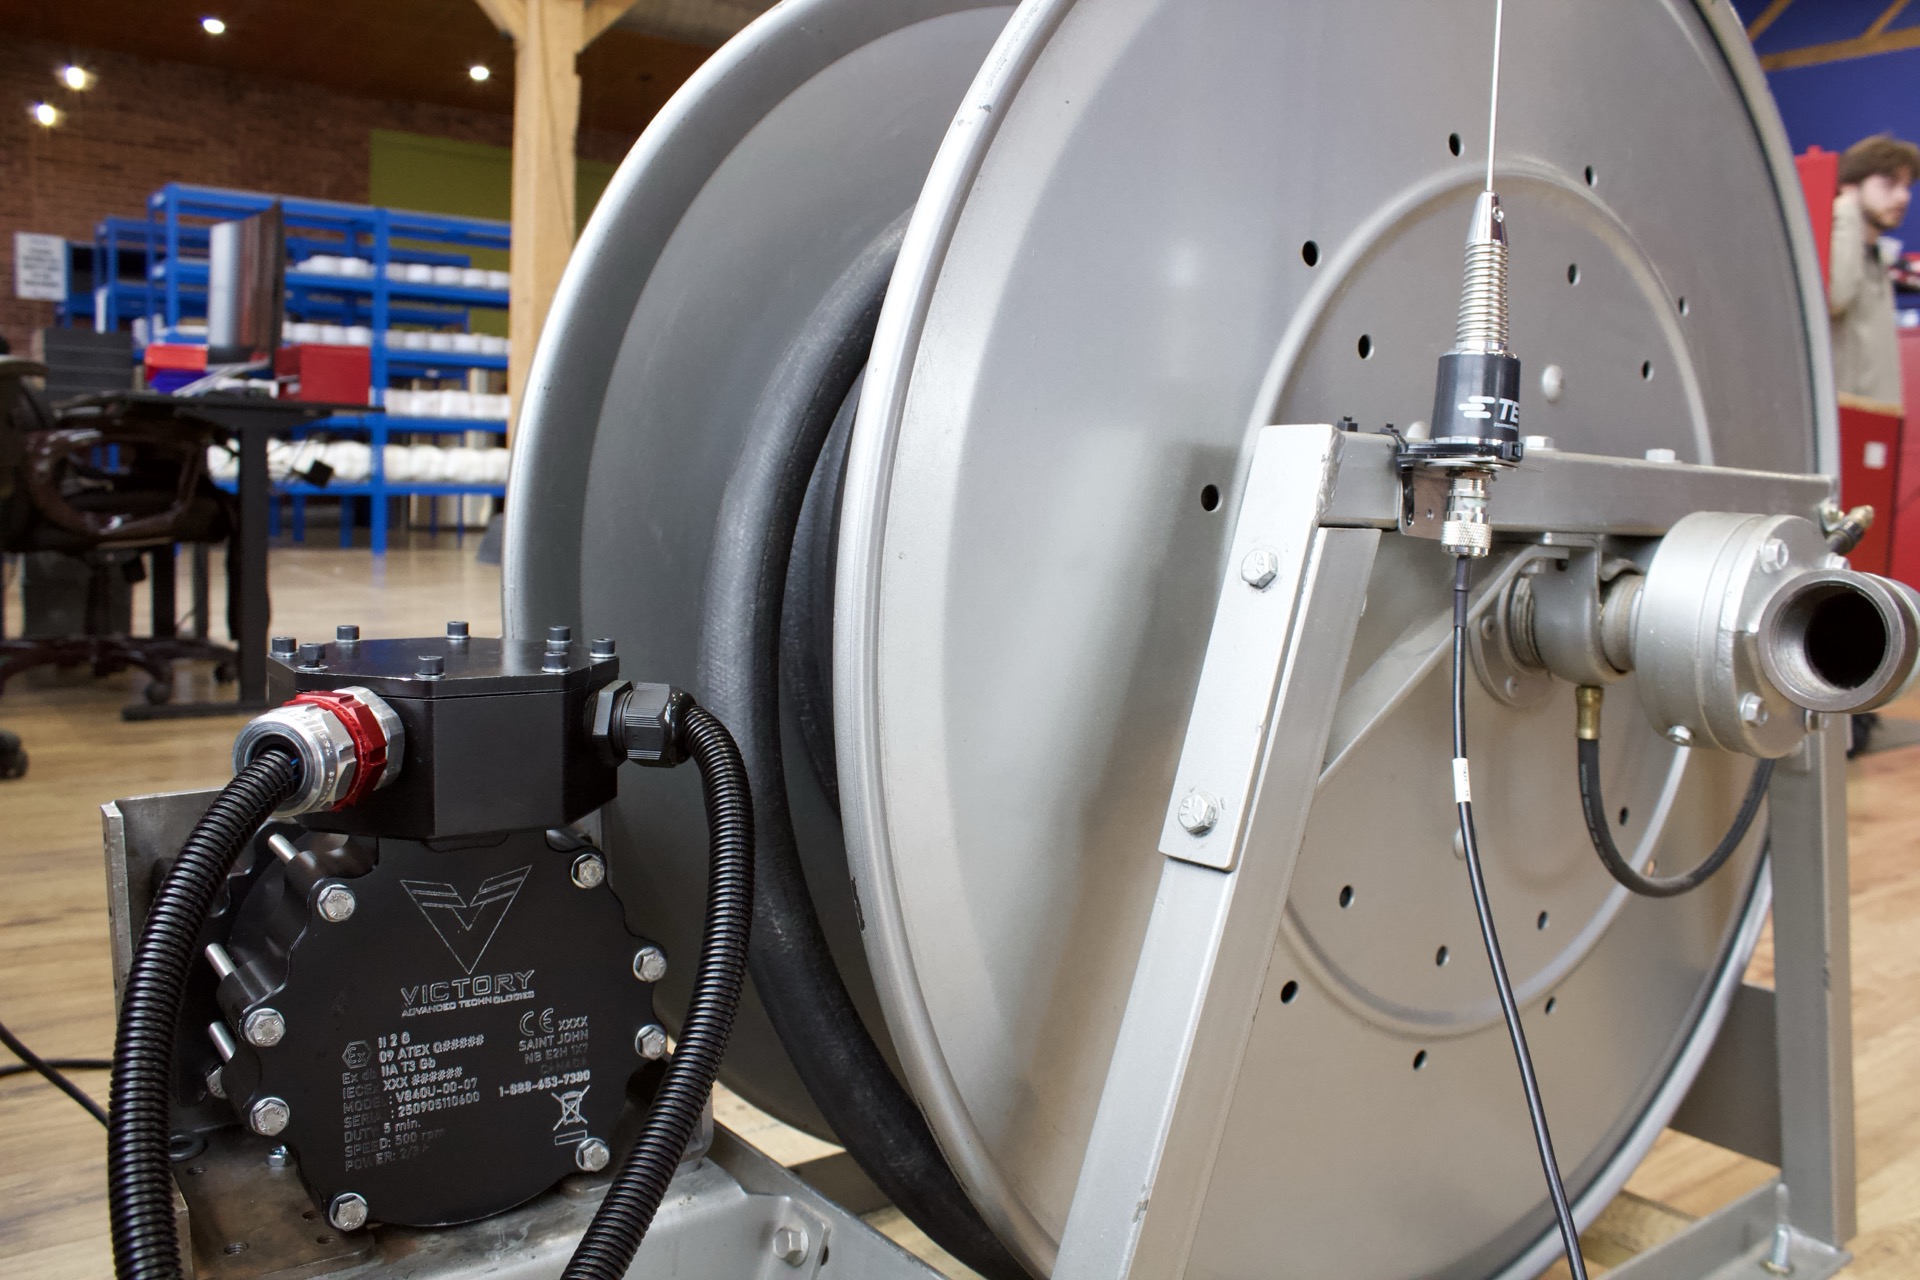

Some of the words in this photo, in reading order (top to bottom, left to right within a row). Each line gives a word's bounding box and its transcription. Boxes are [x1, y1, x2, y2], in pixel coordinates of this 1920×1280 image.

[1499, 397, 1520, 423] TE
[400, 969, 535, 1006] VICTORY
[401, 1000, 457, 1017] ADVANCED
[458, 990, 535, 1008] TECHNOLOGIES
[390, 1033, 399, 1047] 2
[518, 1034, 555, 1052] SAINT
[556, 1028, 589, 1045] JOHN
[378, 1049, 395, 1063] 09
[397, 1043, 430, 1060] ATEX
[524, 1051, 542, 1065] NB
[545, 1046, 568, 1061] E2H
[341, 1071, 359, 1085] Ex
[400, 1060, 416, 1073] T3
[382, 1075, 409, 1092] XXX
[383, 1122, 392, 1134] 5
[394, 1118, 421, 1133] min.
[395, 1131, 418, 1147] 500
